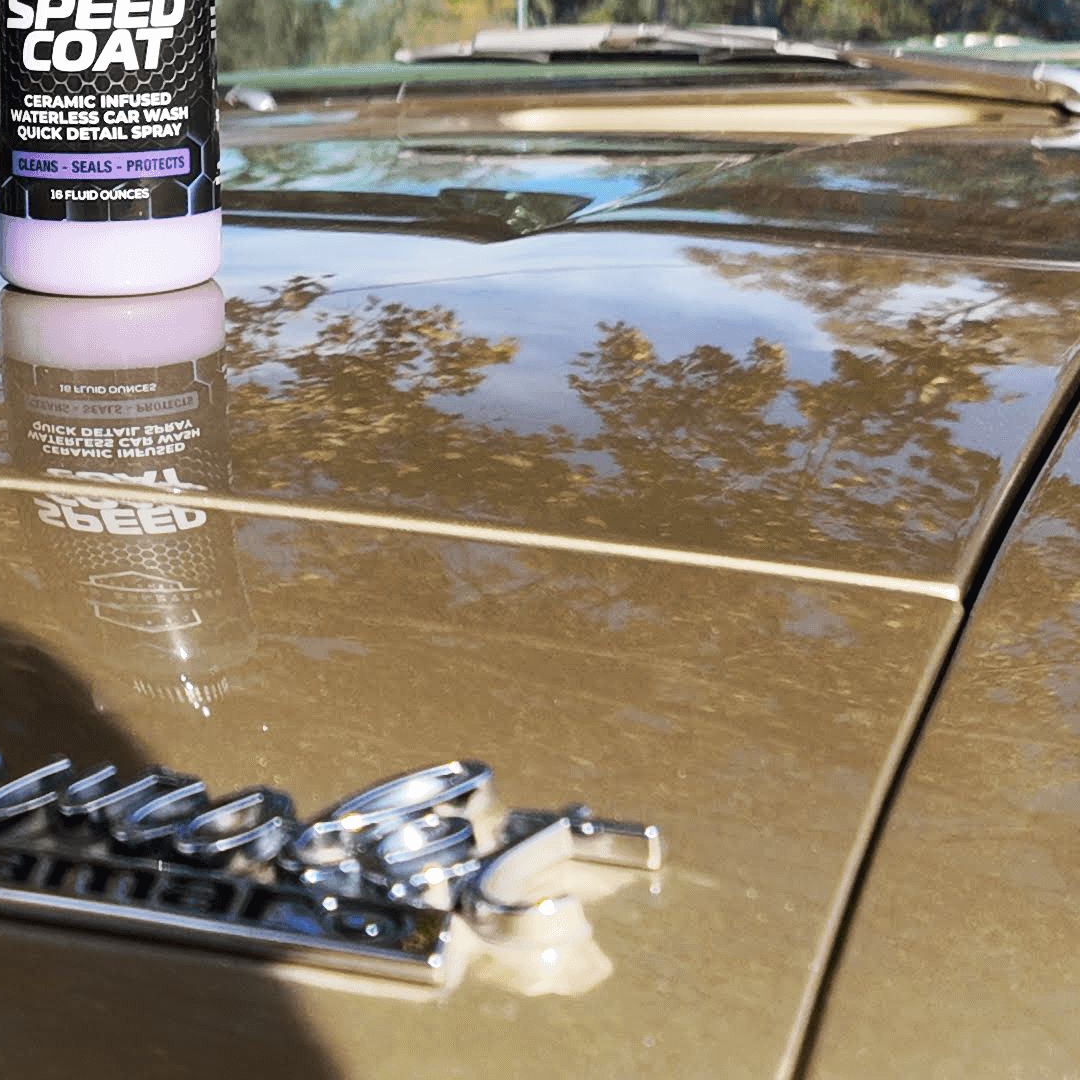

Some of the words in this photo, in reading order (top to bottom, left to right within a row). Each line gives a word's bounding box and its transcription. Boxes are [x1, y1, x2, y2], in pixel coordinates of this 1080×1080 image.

[22, 27, 174, 72] COAT
[23, 94, 96, 109] CERAMIC
[100, 92, 172, 107] INFUSED
[10, 108, 100, 125] WATERLESS
[103, 110, 140, 124] CAR
[144, 106, 189, 122] WASH
[17, 124, 63, 141] QUICK
[66, 126, 128, 141] DETAIL
[131, 123, 182, 139] SPRAY
[18, 157, 59, 173] CLEANS
[71, 160, 113, 174] SEALS
[126, 156, 185, 172] PROTECTS
[64, 189, 99, 201] FLUID
[99, 188, 150, 201] OUNCES
